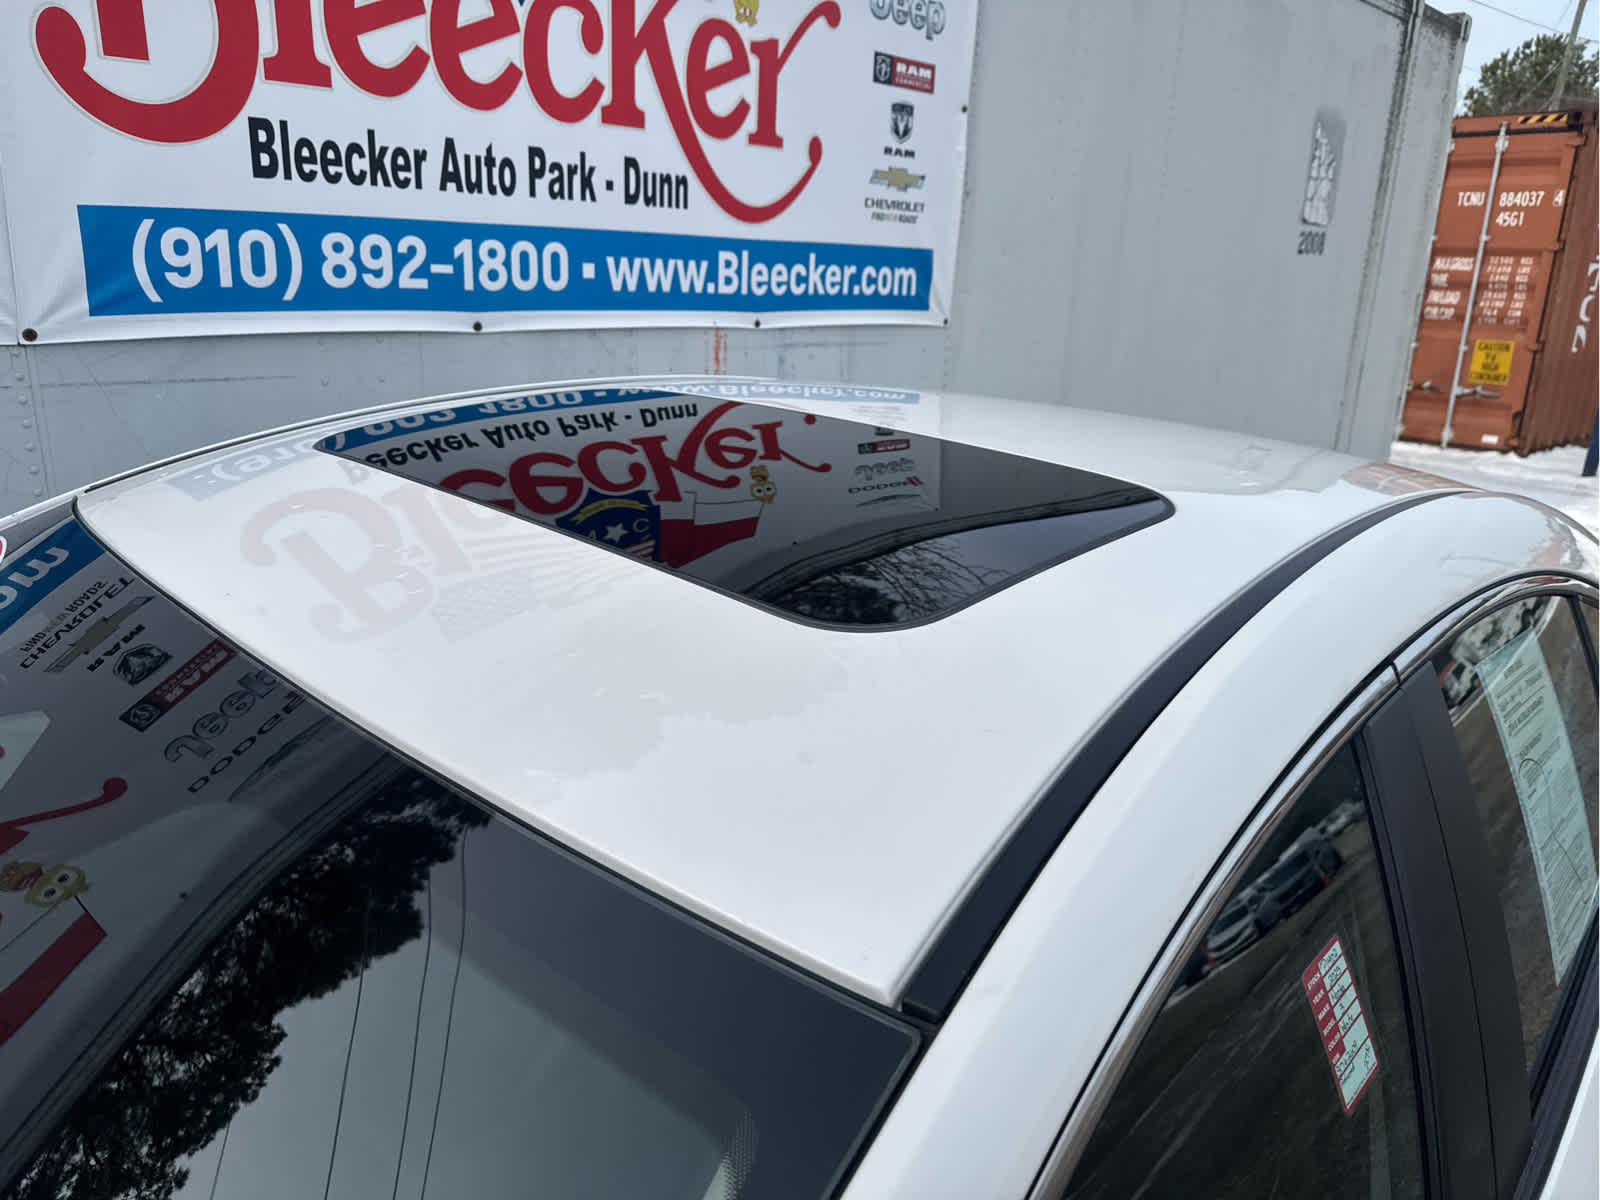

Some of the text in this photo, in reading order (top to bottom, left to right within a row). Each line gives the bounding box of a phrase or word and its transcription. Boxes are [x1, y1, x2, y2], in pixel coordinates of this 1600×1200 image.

[896, 61, 932, 79] RAM
[883, 146, 916, 159] RAM
[248, 116, 689, 210] Bleecker Auto Park Dunn
[864, 197, 925, 213] CHEVROLET
[1457, 189, 1565, 207] TCNU 884037 4
[1496, 212, 1525, 227] 45G1
[132, 218, 917, 303] (910) 892-1800 www.Bleecker.com
